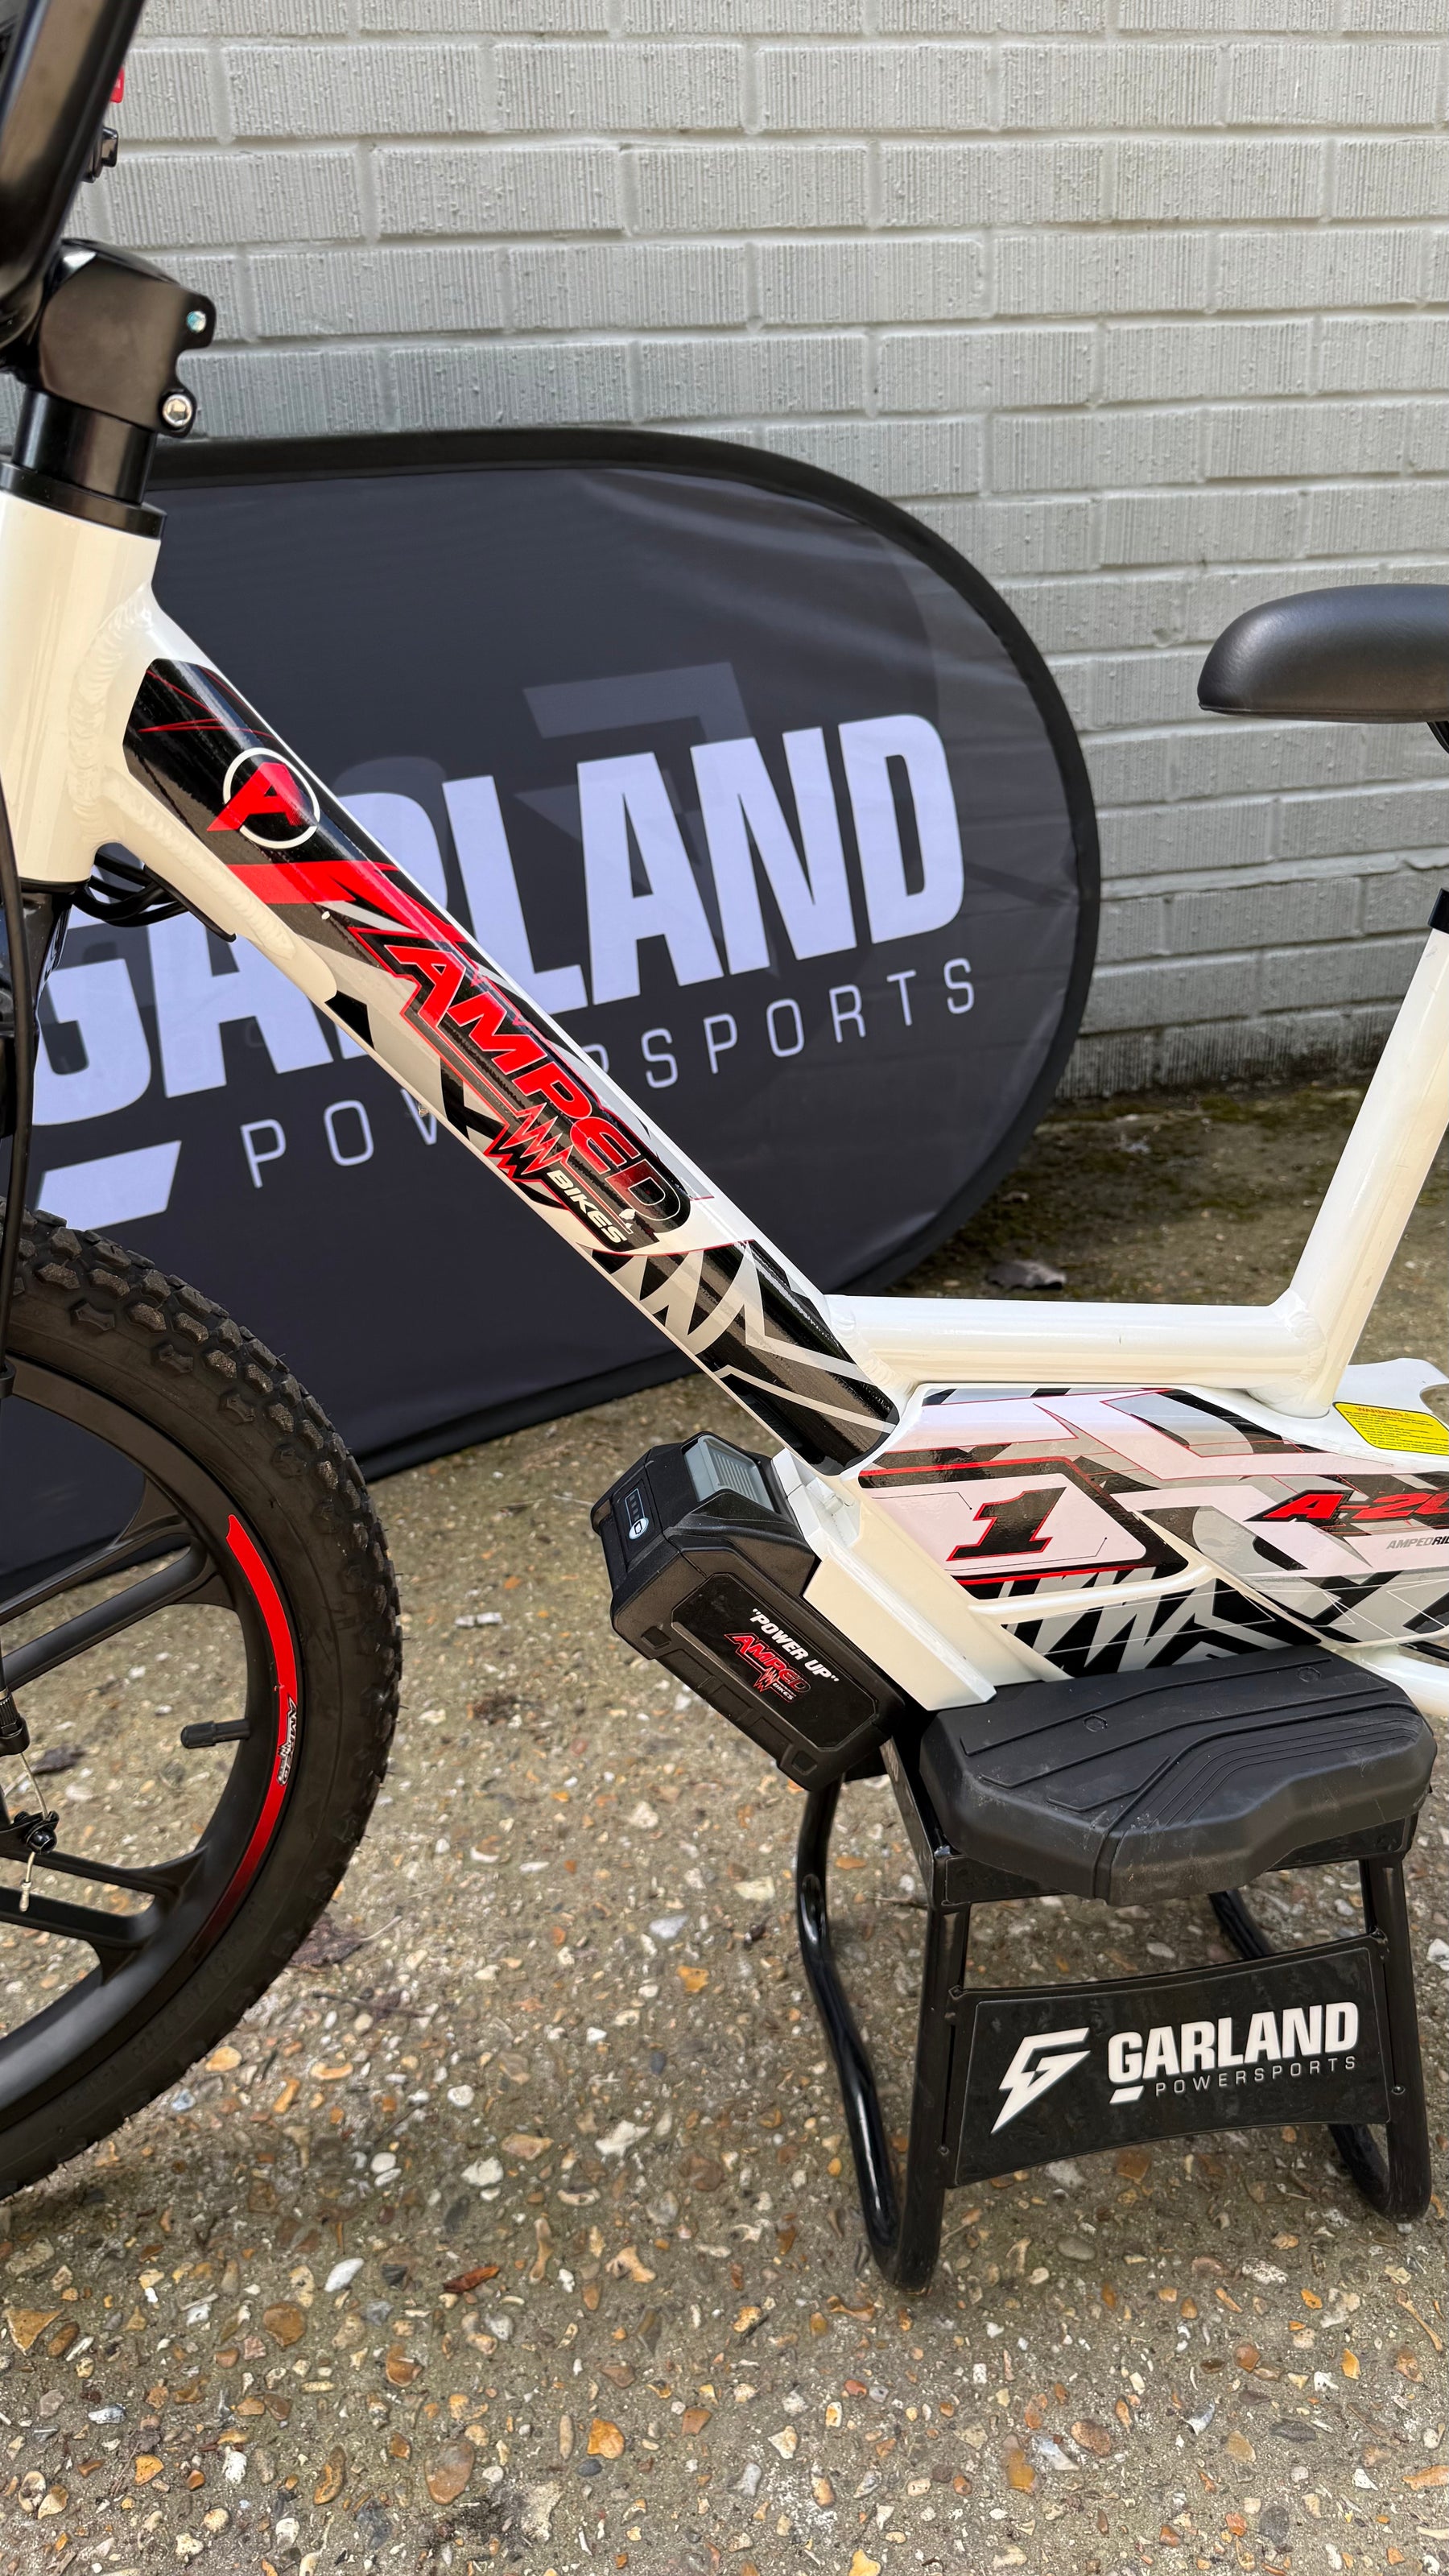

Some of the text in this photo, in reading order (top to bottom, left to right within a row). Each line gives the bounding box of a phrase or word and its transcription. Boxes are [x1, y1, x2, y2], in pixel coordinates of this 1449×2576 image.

[240, 957, 976, 1190] POSPORTS
[384, 944, 682, 1222] AMPED
[546, 1168, 628, 1245] BIKES
[947, 1486, 1067, 1562] 1
[732, 1635, 811, 1693] AMPED
[772, 1682, 795, 1701] BIKES
[1107, 2001, 1359, 2083] GARLAND
[1155, 2055, 1356, 2096] POWERSPORTS
